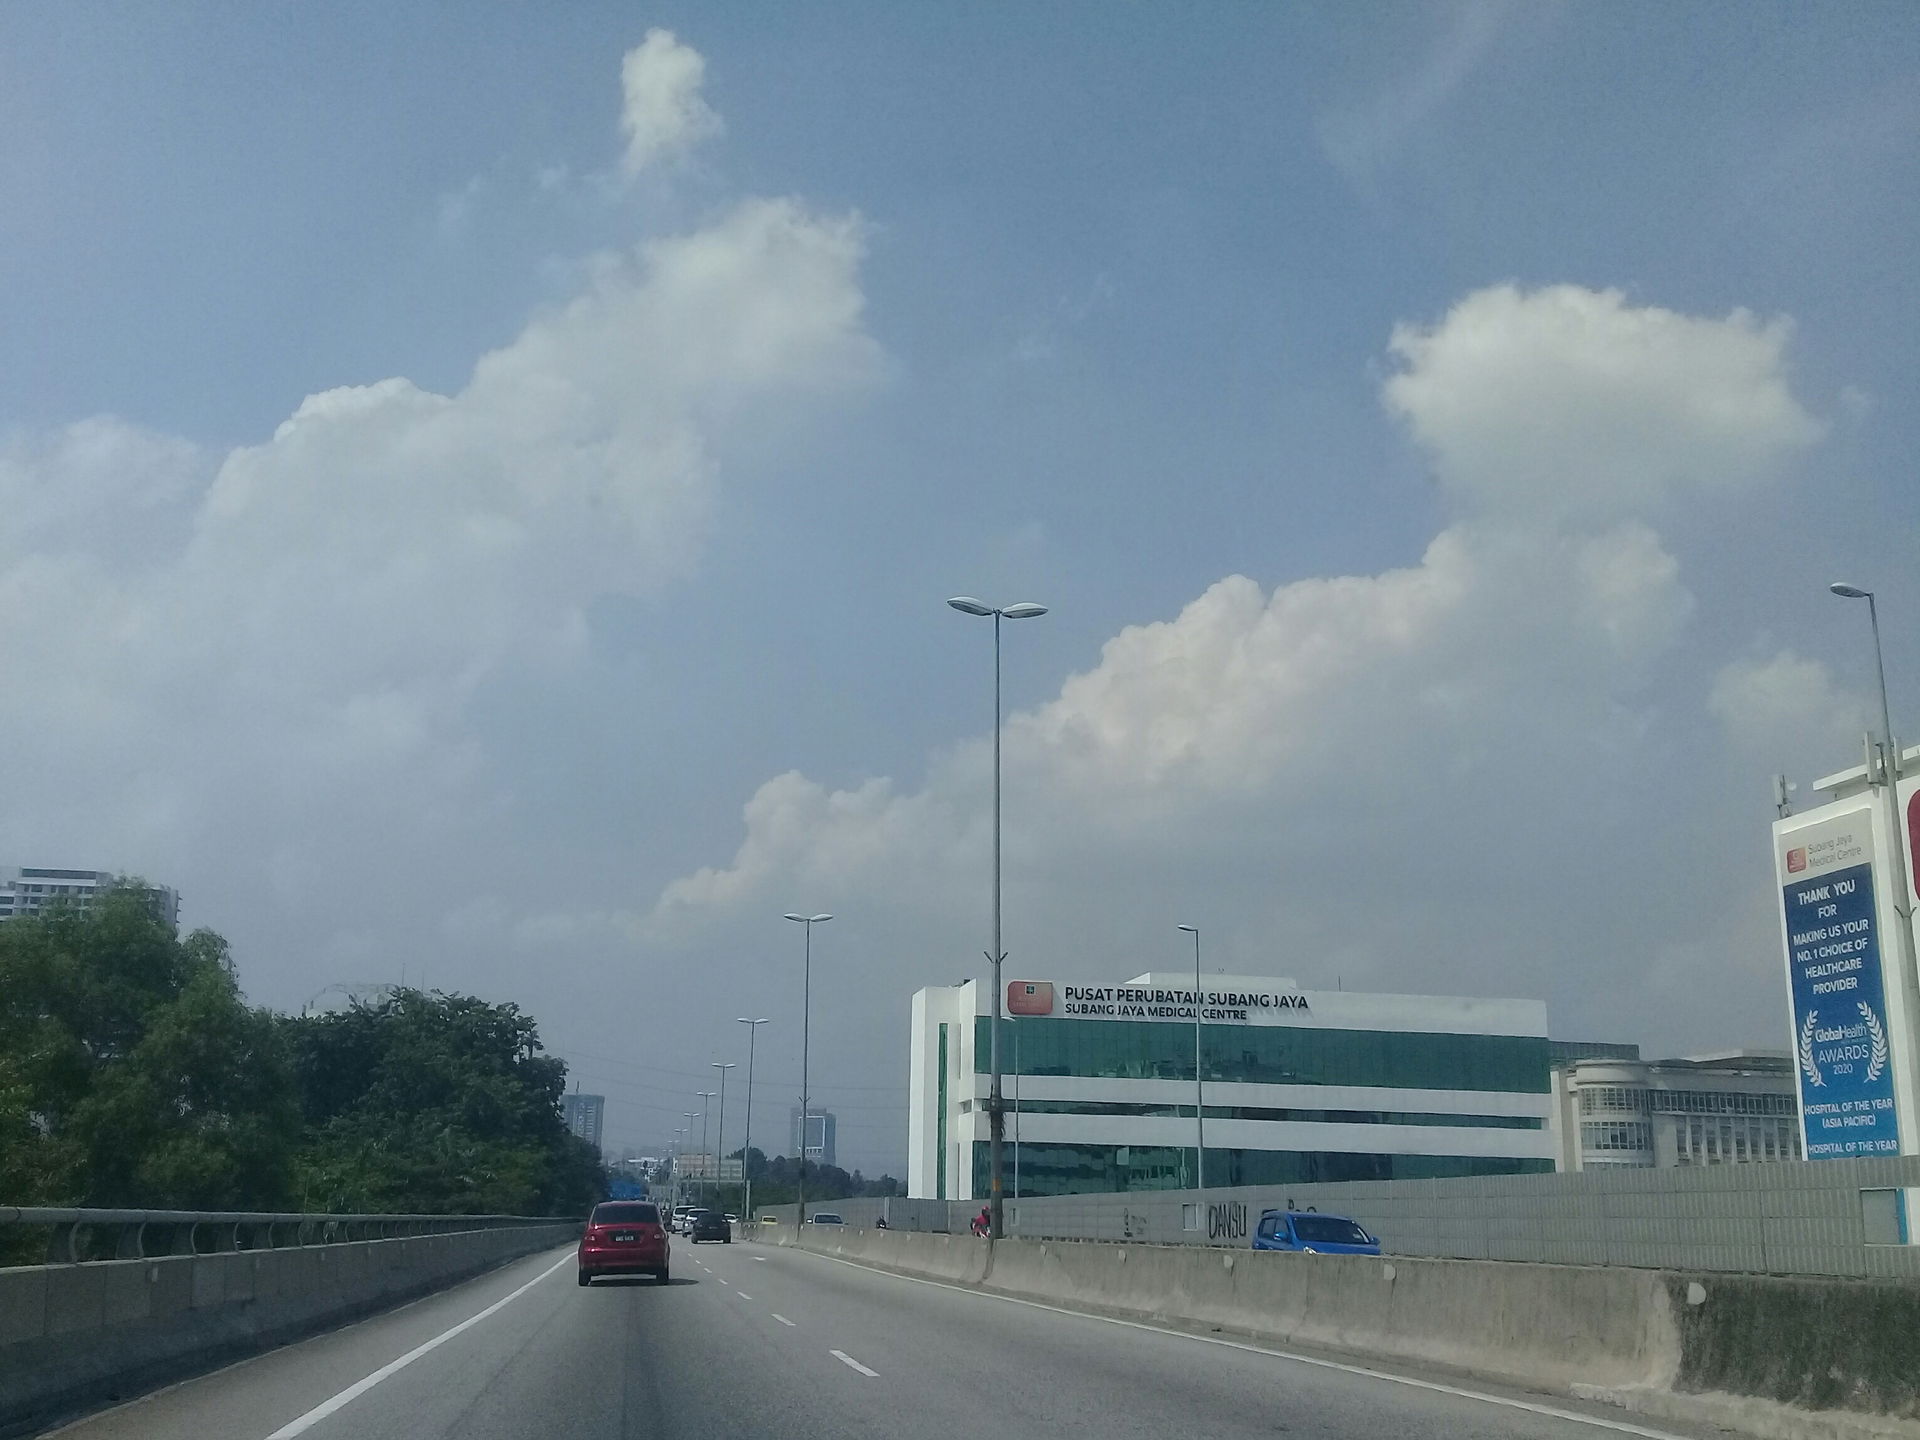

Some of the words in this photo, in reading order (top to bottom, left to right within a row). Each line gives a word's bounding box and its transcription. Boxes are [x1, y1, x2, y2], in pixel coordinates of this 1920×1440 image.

[1837, 846, 1862, 861] Centre
[1798, 886, 1831, 905] THANK
[1834, 879, 1856, 896] YOU
[1818, 904, 1837, 919] FOR
[1793, 928, 1827, 946] MAKING
[1829, 924, 1841, 938] US
[1841, 919, 1869, 936] YOUR
[1797, 948, 1812, 963] NO.
[1819, 942, 1853, 958] CHOICE
[1855, 937, 1868, 951] OF
[1805, 958, 1863, 979] HEALTHCARE
[1813, 977, 1858, 995] PROVIDER
[1065, 986, 1113, 1002] PUSAT
[1117, 989, 1204, 1005] PERUBATAN
[1208, 992, 1270, 1008] SUBANG
[1273, 995, 1308, 1009] JAYA
[1065, 1003, 1114, 1016] SUBANG
[1117, 1005, 1145, 1017] JAYA
[1148, 1006, 1198, 1018] MEDICAL
[1201, 1008, 1247, 1020] CENTRE
[1815, 1022, 1867, 1043] GlobalHealth
[1818, 1044, 1869, 1064] AWARDS
[1833, 1063, 1853, 1075] 2020
[1804, 1103, 1840, 1115] HOSPITAL
[1842, 1101, 1853, 1112] OF
[1854, 1100, 1870, 1111] THE
[1871, 1098, 1893, 1110] YEAR
[1822, 1118, 1842, 1129] (ASIA
[1844, 1115, 1876, 1128] PACIFIC)
[1808, 1142, 1844, 1155] HOSPITAL
[1846, 1141, 1857, 1152] OF
[1858, 1140, 1873, 1151] THE
[1875, 1139, 1897, 1151] YEAR
